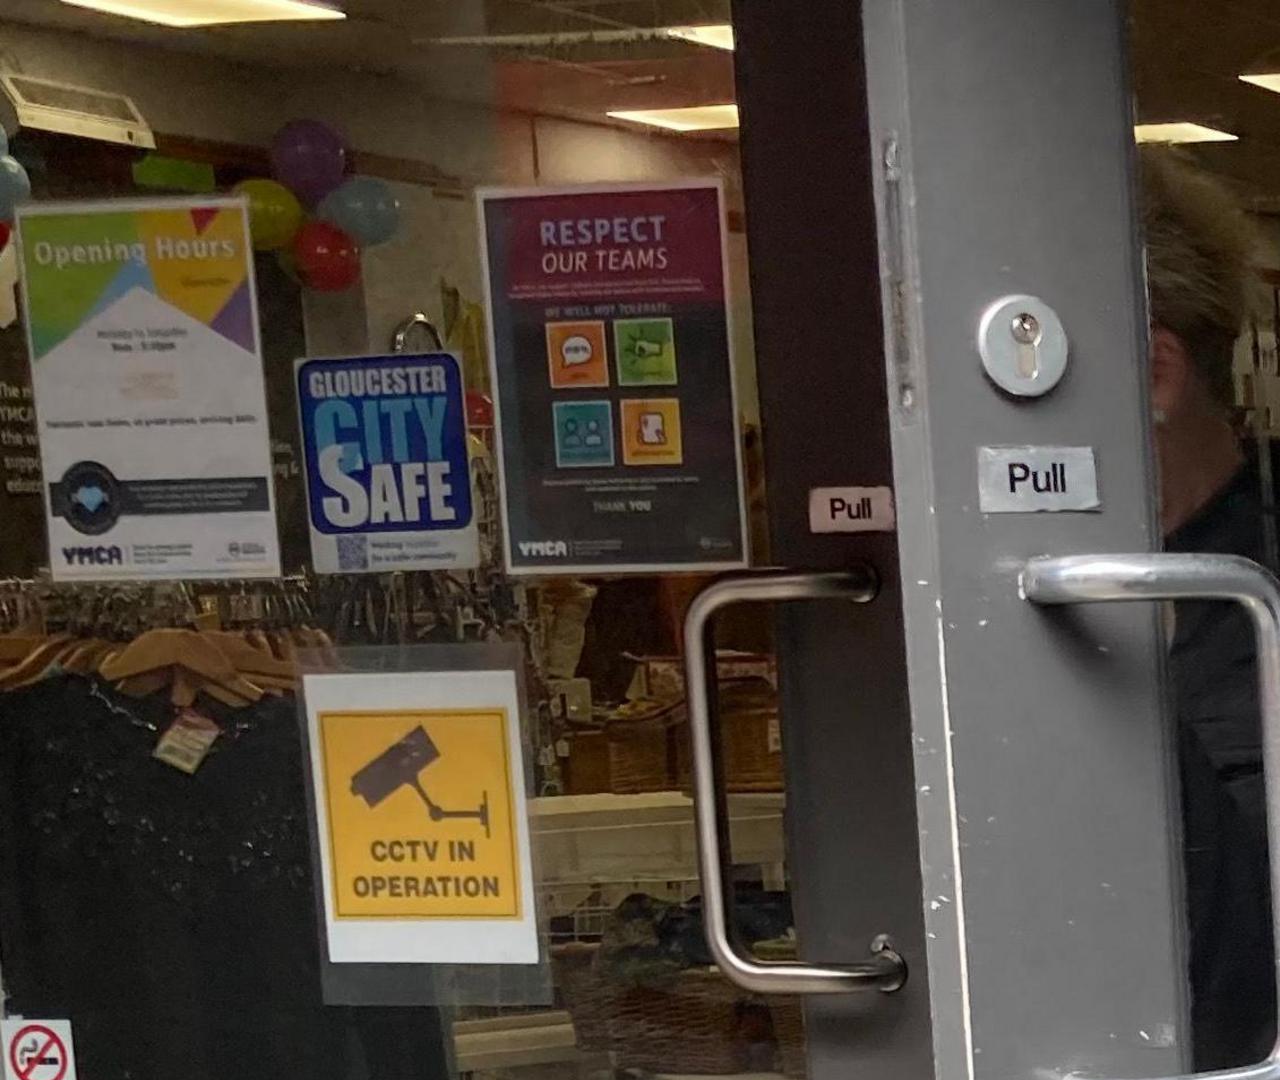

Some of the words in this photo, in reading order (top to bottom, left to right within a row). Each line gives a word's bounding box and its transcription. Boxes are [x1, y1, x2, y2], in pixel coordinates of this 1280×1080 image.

[539, 214, 667, 247] RESPECT
[34, 237, 148, 268] Opening
[155, 235, 237, 260] Hours
[541, 250, 588, 274] OUR
[595, 247, 669, 272] TEAMS
[308, 364, 448, 399] GLOUCESTER
[313, 395, 448, 474] CITY
[318, 443, 457, 528] SAFE
[1008, 463, 1067, 493] Pull
[629, 500, 652, 512] YOU
[829, 497, 872, 520] Pull
[61, 545, 124, 566] YMCA
[518, 541, 568, 557] YMCA
[369, 840, 439, 863] CCTV
[449, 839, 476, 862] IN
[352, 875, 500, 899] OPERATION
